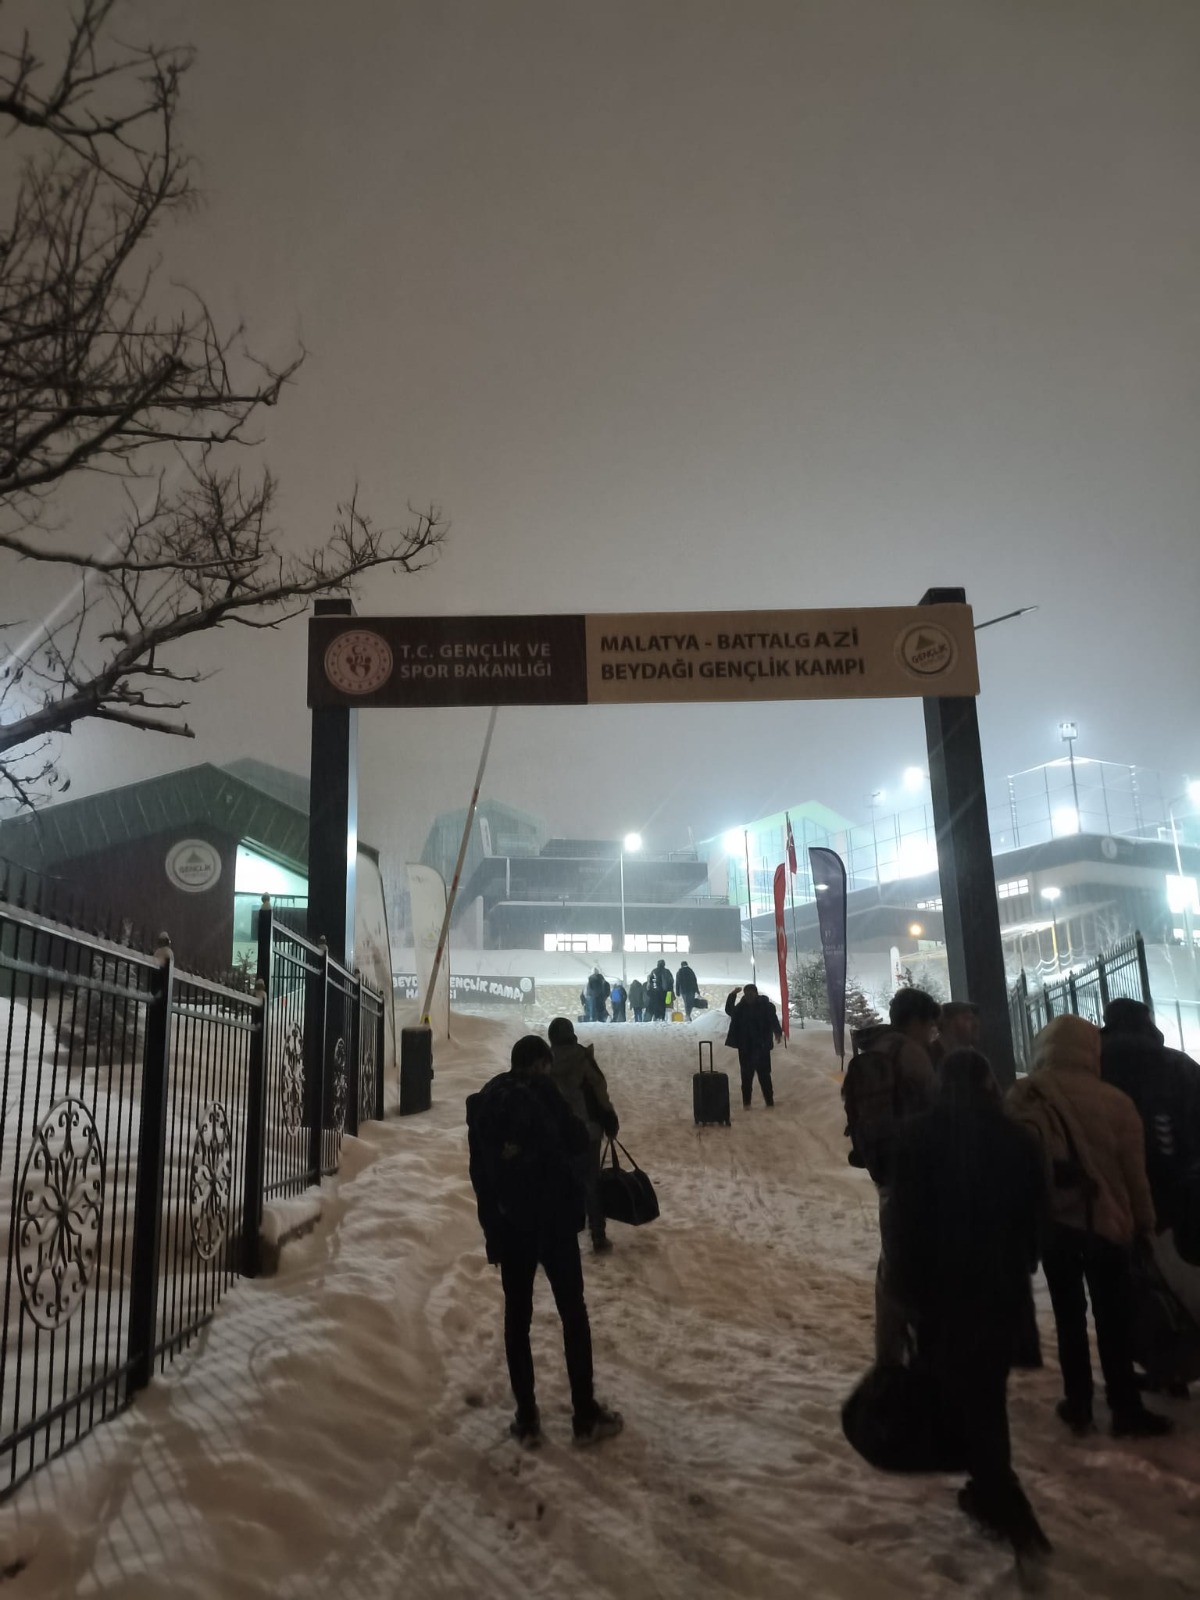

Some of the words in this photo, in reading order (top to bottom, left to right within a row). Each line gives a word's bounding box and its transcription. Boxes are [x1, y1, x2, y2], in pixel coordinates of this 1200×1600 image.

[601, 634, 700, 652] MALATYA
[717, 627, 859, 651] BATTALGAZİ
[400, 644, 434, 659] T.C.
[440, 641, 522, 661] GENÇLİK
[527, 643, 552, 657] VE
[400, 663, 449, 679] SPOR
[454, 660, 552, 678] BAKANLIĞI
[601, 658, 693, 680] BEYDAĞI
[699, 657, 791, 683] GENÇLİK
[795, 658, 865, 677] KAMPI
